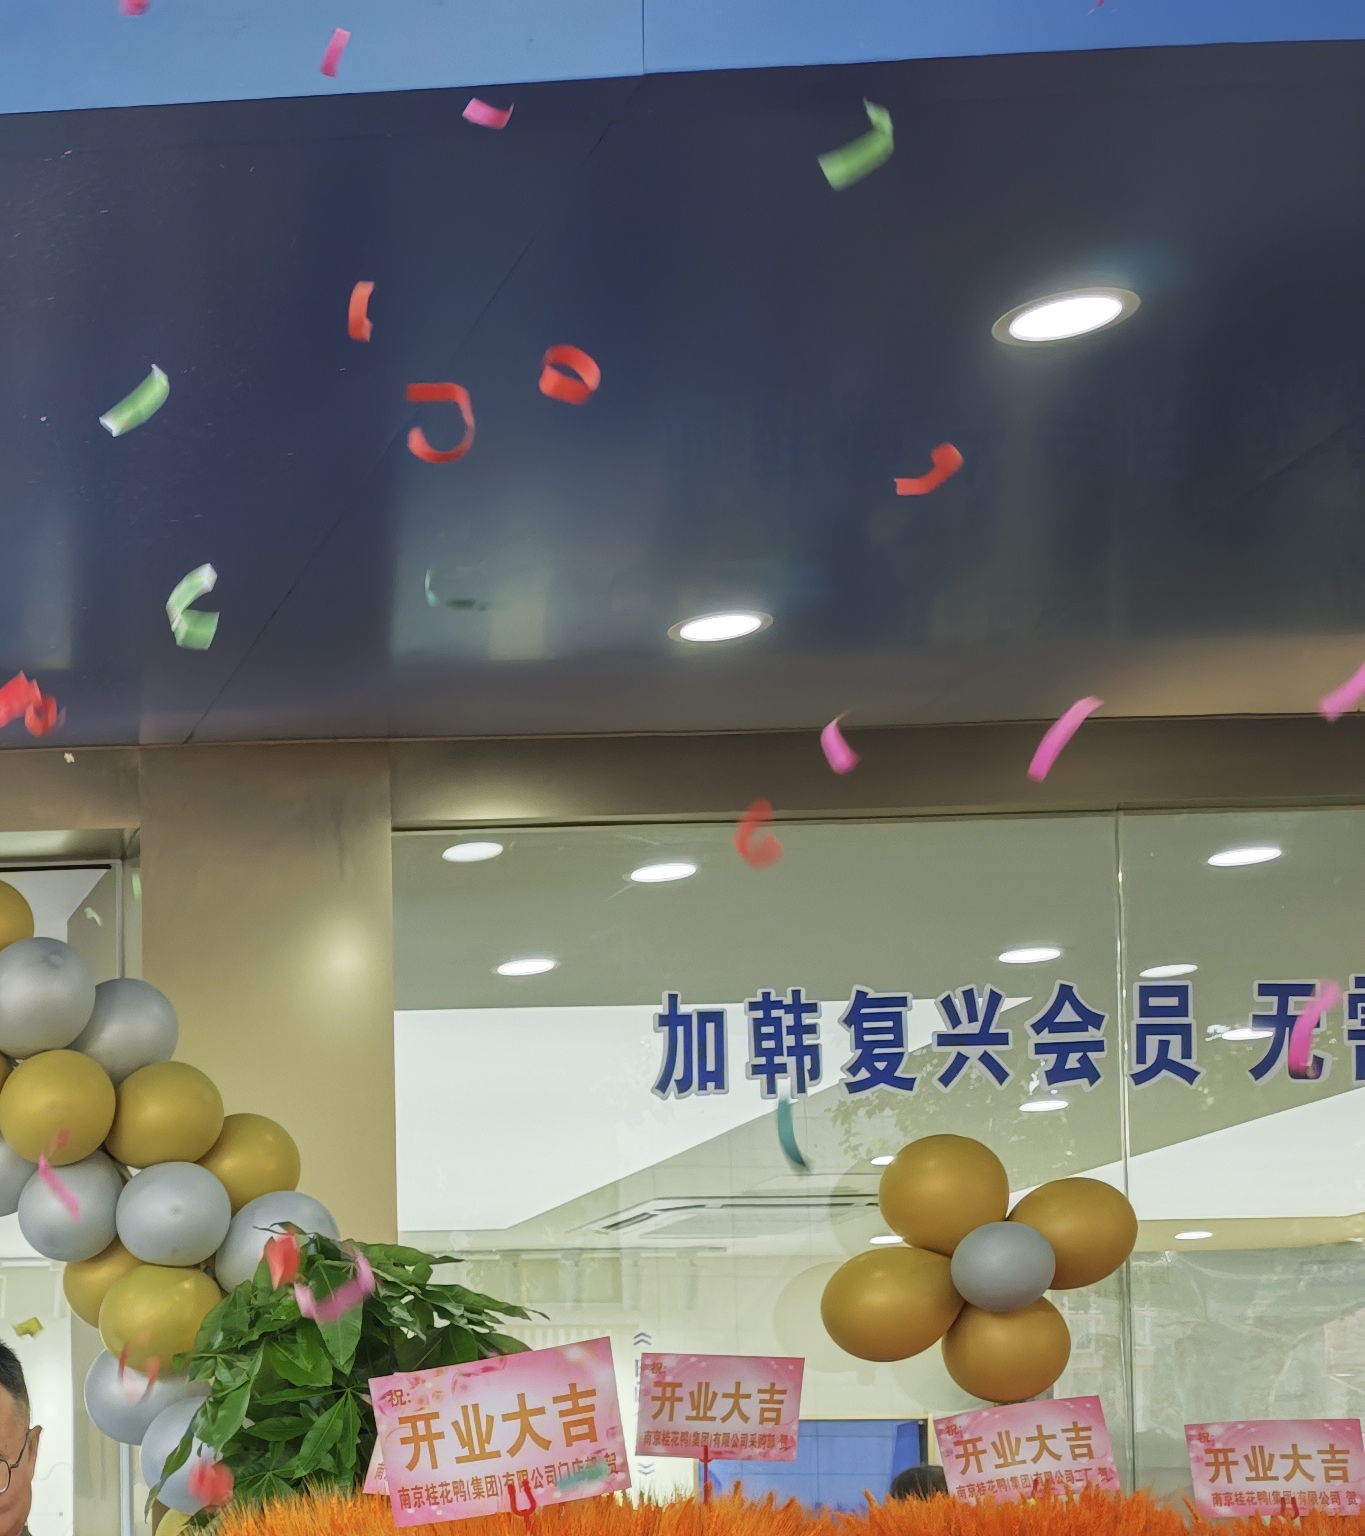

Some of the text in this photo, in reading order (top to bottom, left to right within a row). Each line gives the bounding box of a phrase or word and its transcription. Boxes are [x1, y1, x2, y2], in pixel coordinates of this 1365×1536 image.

[655, 977, 1365, 1096] 加韩复兴会员 无
[397, 1382, 599, 1473] 开业大吉
[651, 1380, 788, 1426] 开业大吉
[953, 1420, 1095, 1476] 开业大吉
[1204, 1443, 1351, 1484] 开业大吉
